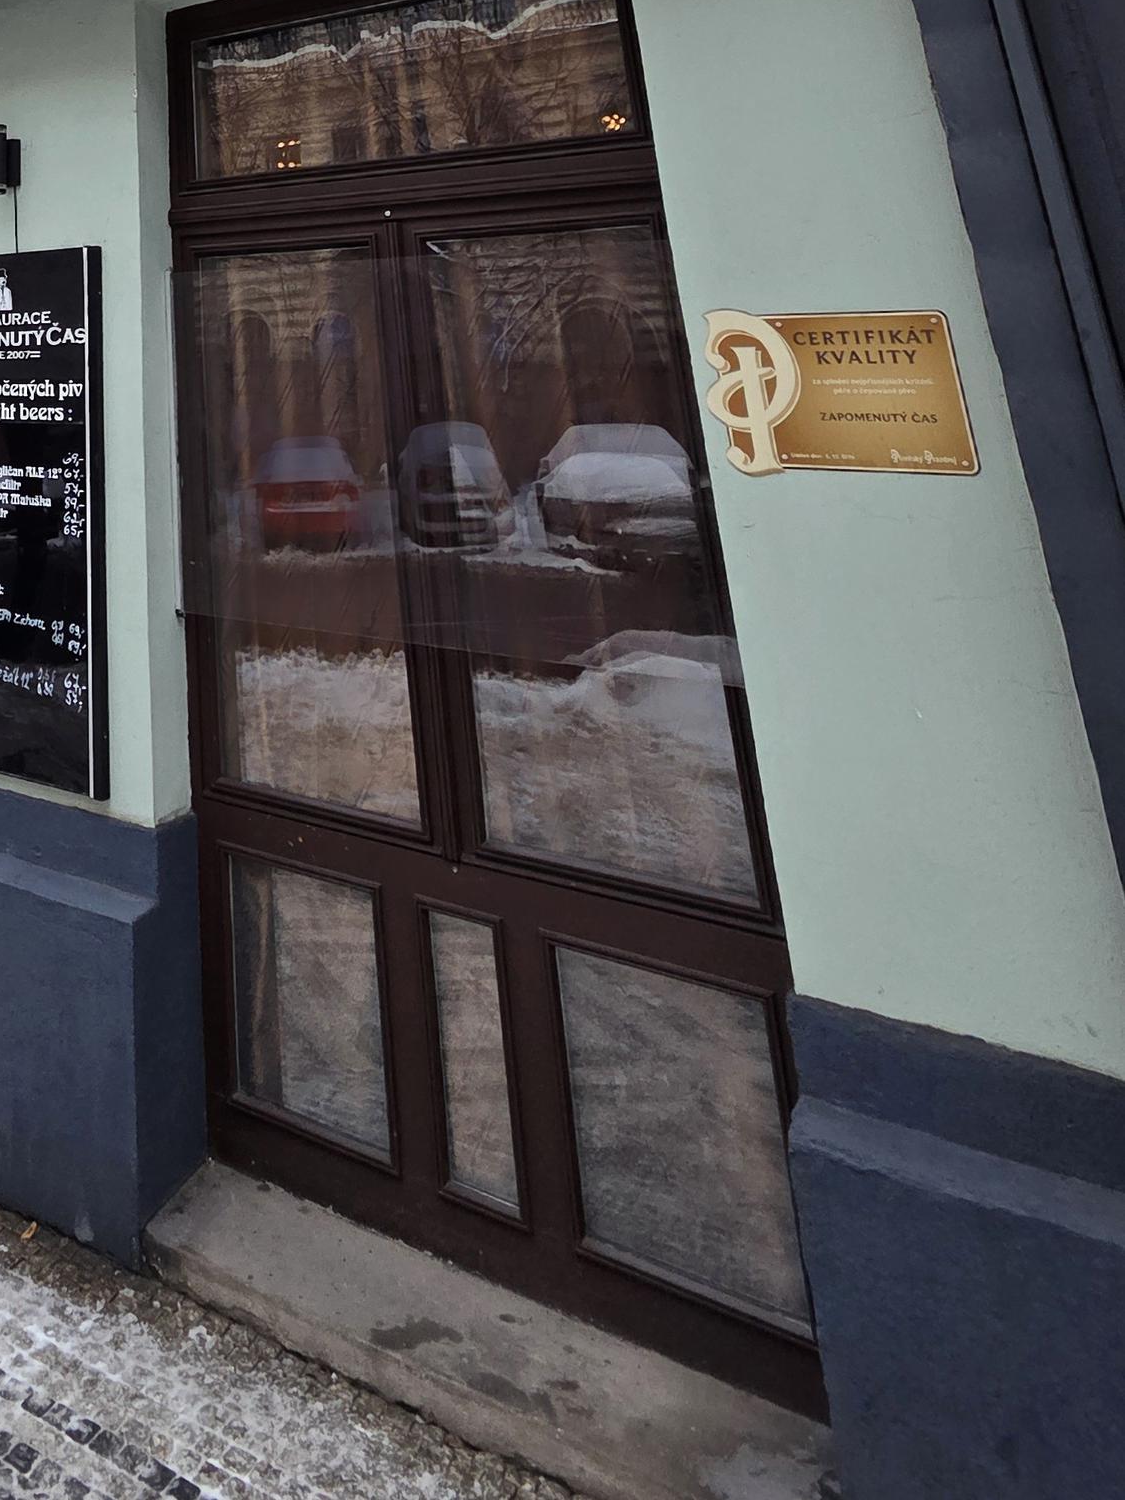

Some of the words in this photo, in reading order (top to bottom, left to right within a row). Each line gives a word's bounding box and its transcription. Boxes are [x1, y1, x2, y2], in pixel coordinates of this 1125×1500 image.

[46, 322, 87, 346] ČAS
[792, 325, 936, 346] CERTIFIKÁT
[6, 350, 31, 360] 2007
[815, 349, 917, 365] KVALITY
[59, 380, 83, 400] piv
[819, 411, 908, 423] ZAPOMENUTÝ
[911, 411, 938, 424] ČAS
[10, 494, 52, 507] Matuška
